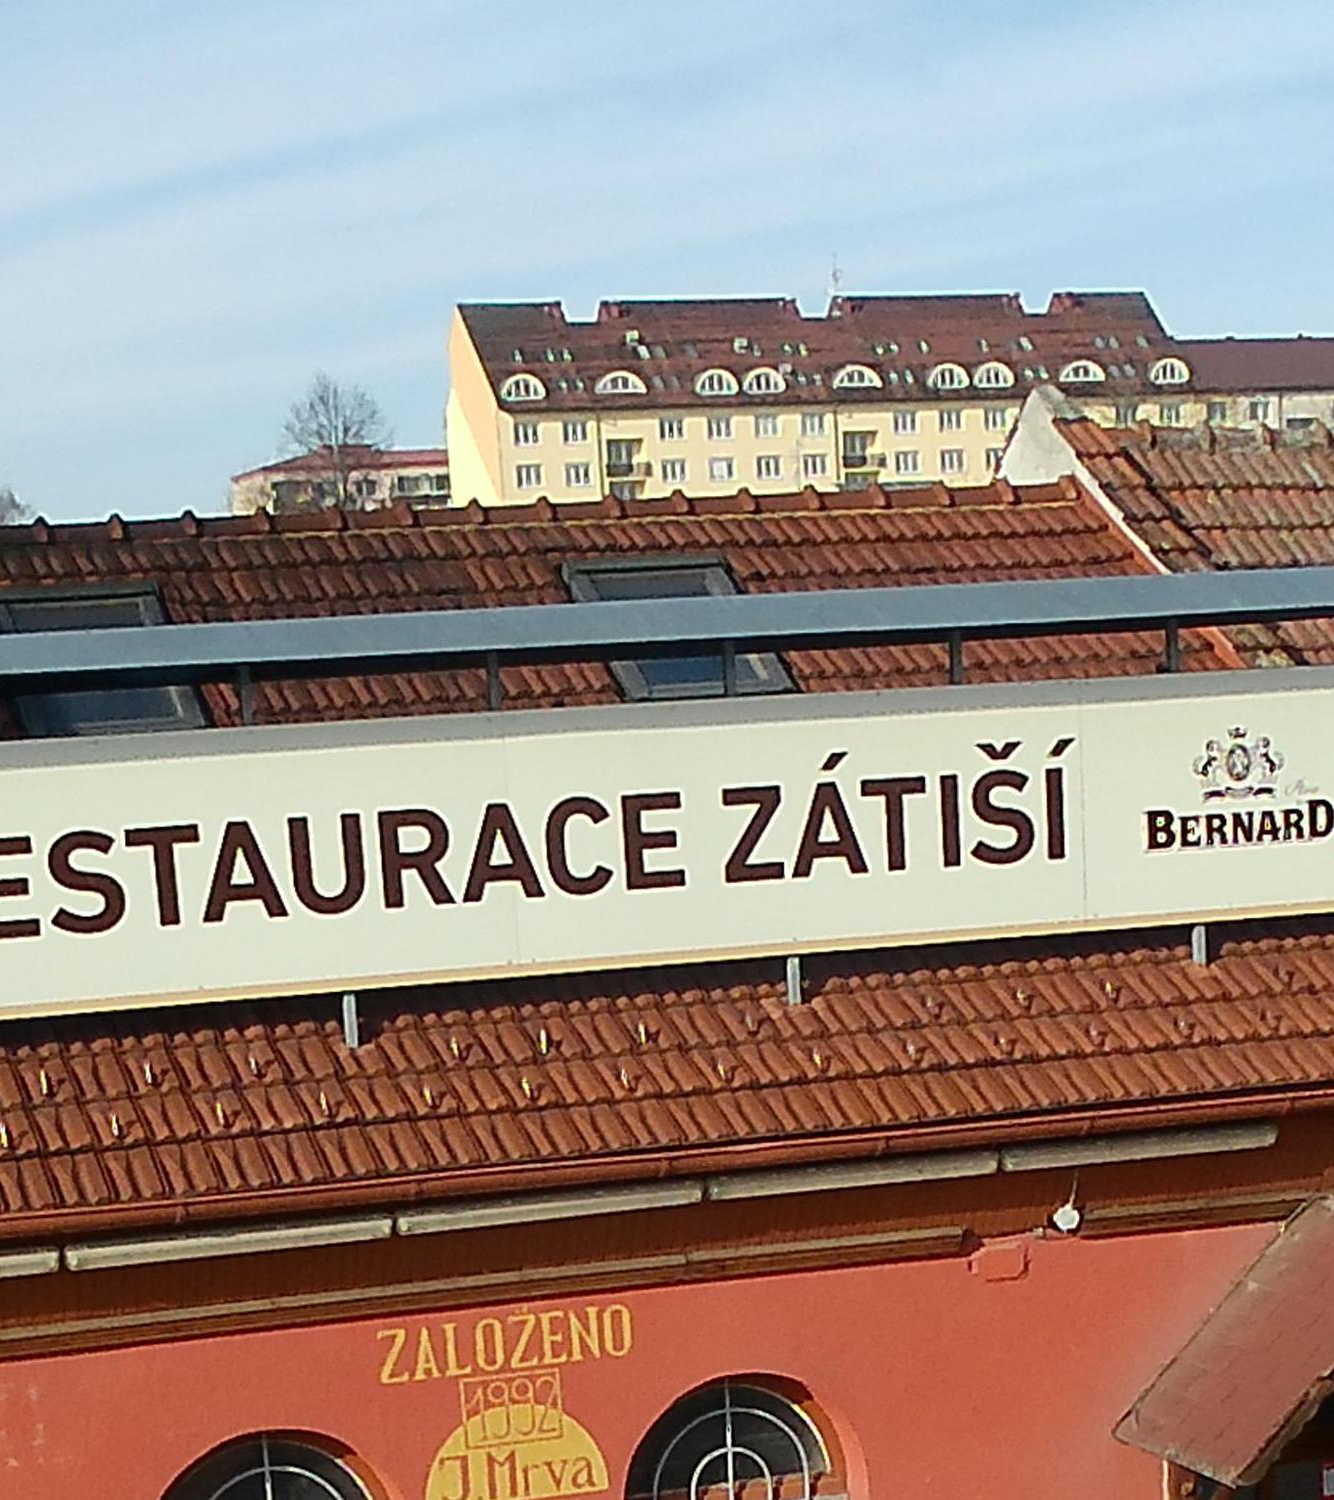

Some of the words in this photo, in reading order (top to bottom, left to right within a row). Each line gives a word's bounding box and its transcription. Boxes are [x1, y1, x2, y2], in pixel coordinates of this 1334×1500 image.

[720, 737, 1075, 883] ZÁTIŠÍ
[1144, 799, 1334, 850] BERNARD
[376, 1304, 634, 1385] ZALOŽENO
[467, 1378, 558, 1442] 1992
